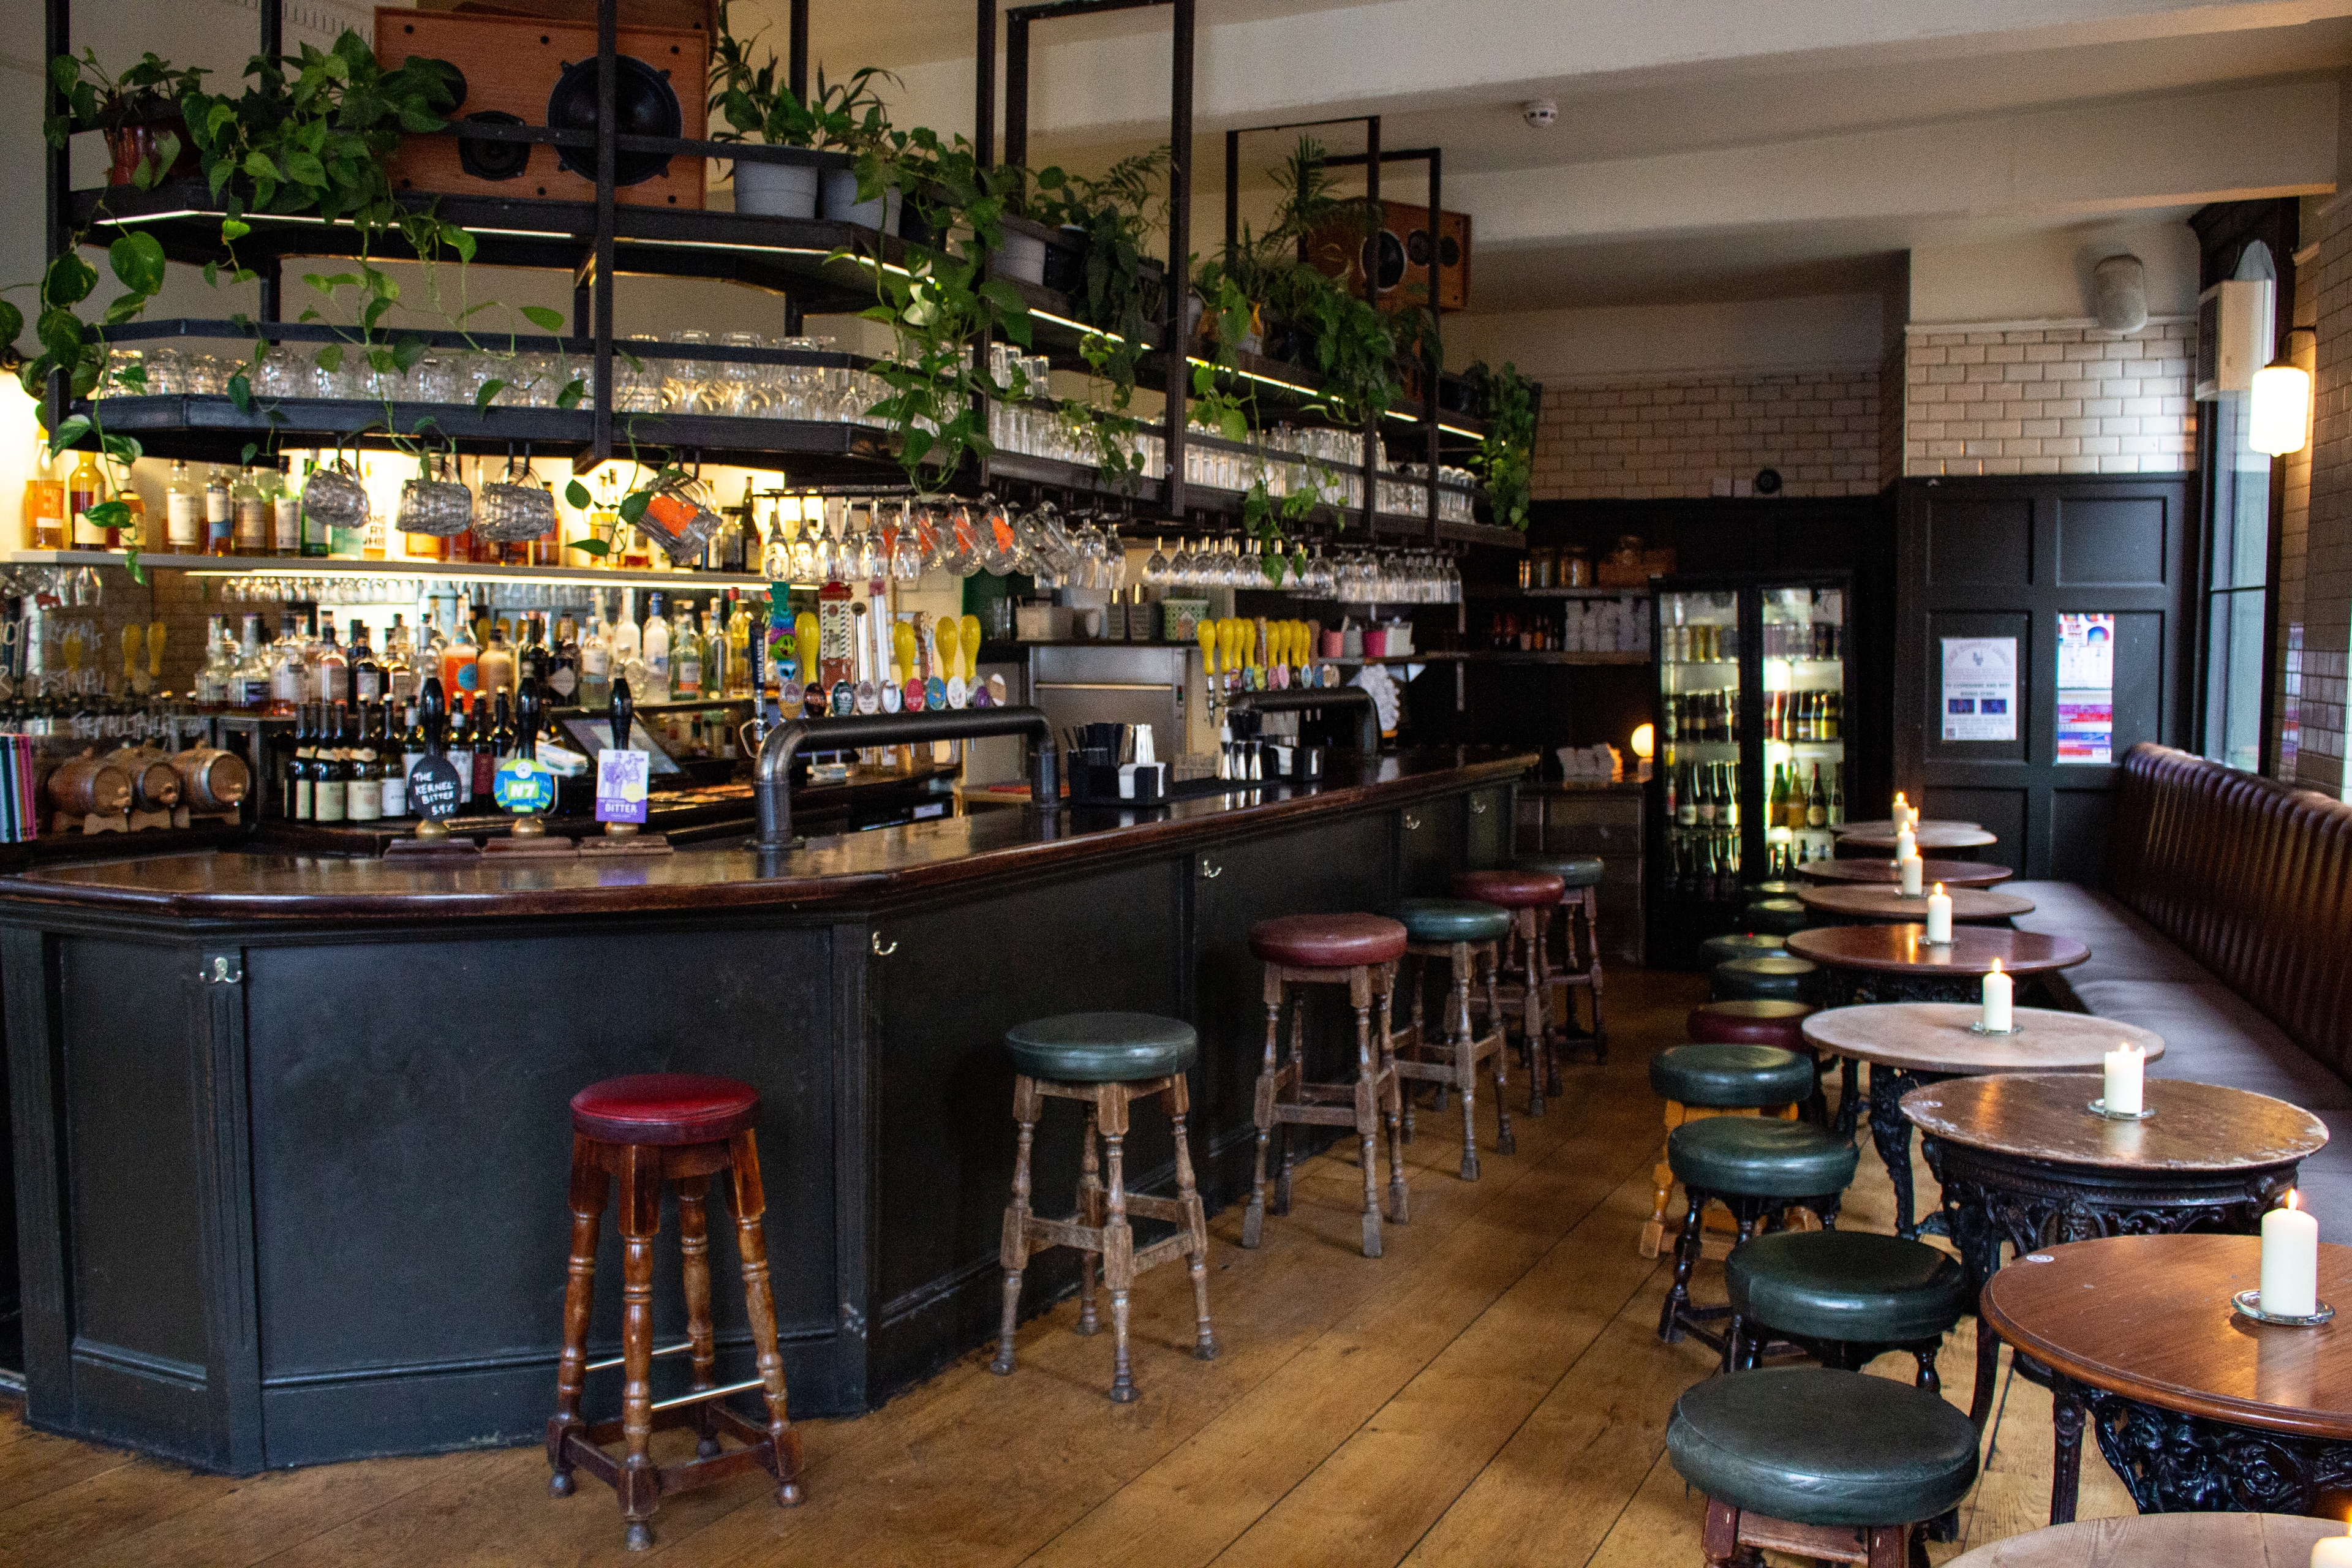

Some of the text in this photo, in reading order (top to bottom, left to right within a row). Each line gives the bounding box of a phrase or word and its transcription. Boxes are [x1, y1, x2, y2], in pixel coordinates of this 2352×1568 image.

[756, 639, 765, 683] PAULANER
[412, 771, 433, 782] THE
[415, 781, 454, 796] KERNEL
[510, 783, 535, 797] N7
[421, 790, 454, 805] BITTER
[605, 803, 638, 814] BITTER
